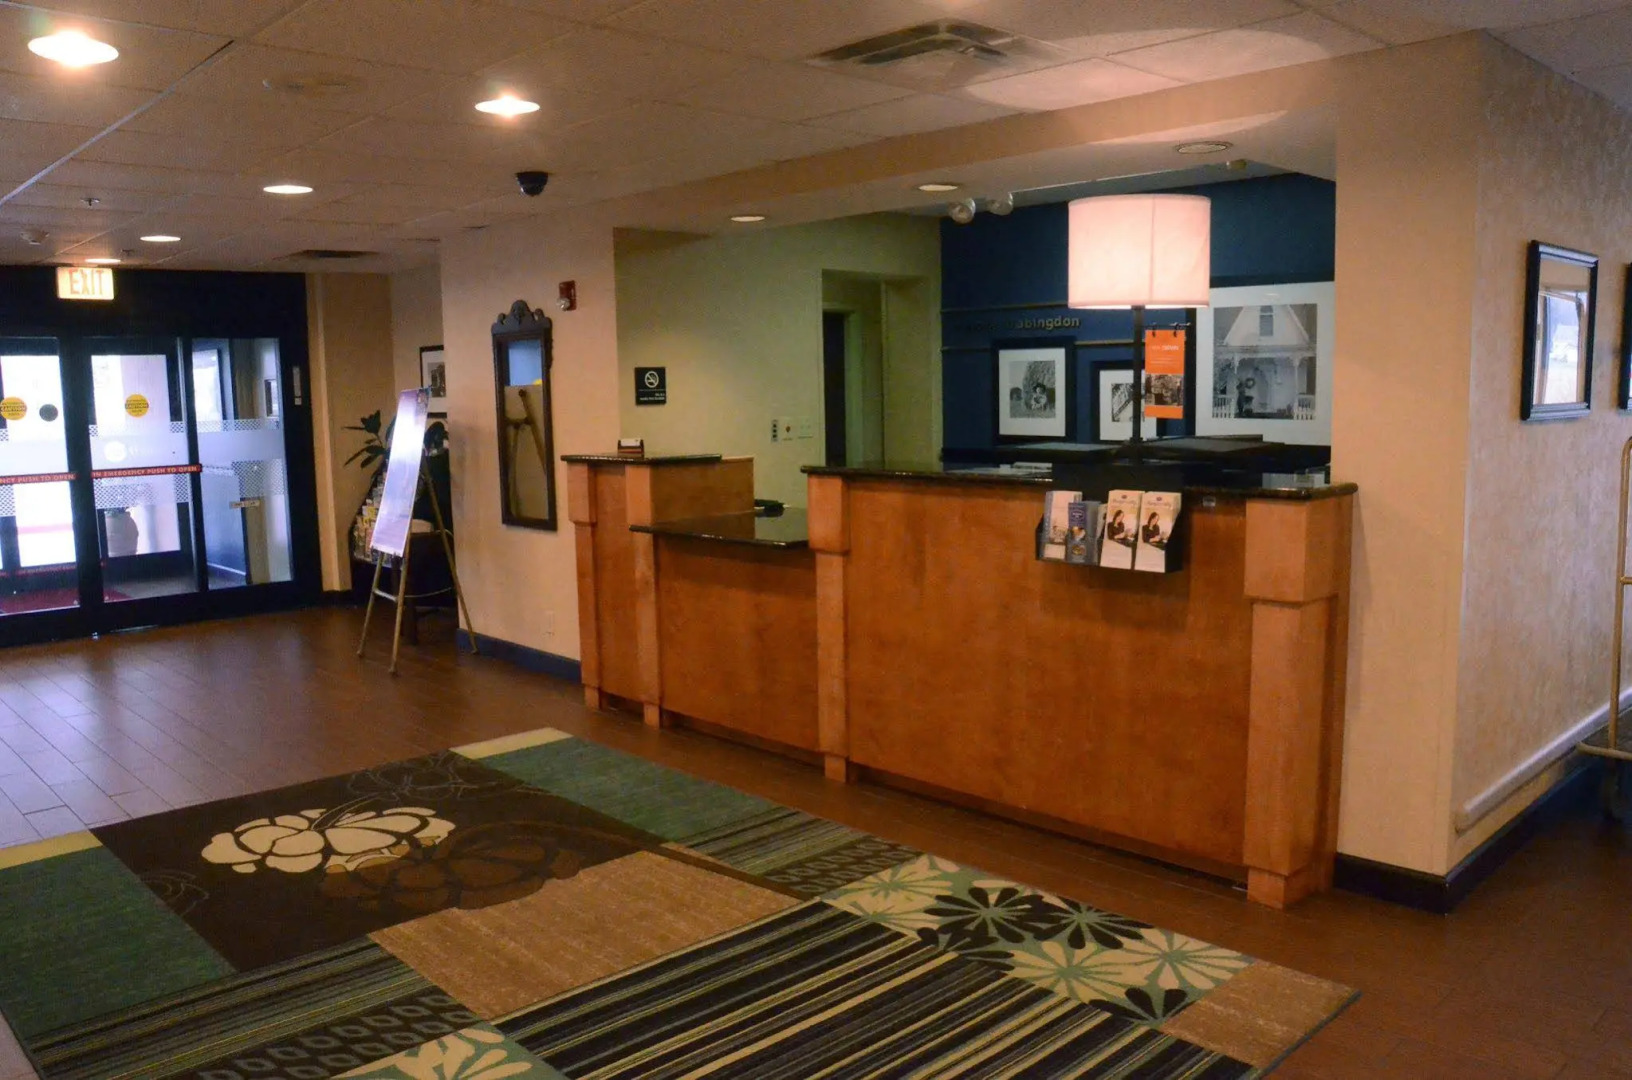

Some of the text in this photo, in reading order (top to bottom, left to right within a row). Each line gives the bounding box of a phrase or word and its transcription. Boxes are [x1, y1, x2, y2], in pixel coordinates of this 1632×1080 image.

[68, 269, 104, 295] EXIT
[1017, 315, 1080, 330] abingdon
[104, 469, 145, 477] EMERGENCY
[178, 465, 197, 473] OPEN
